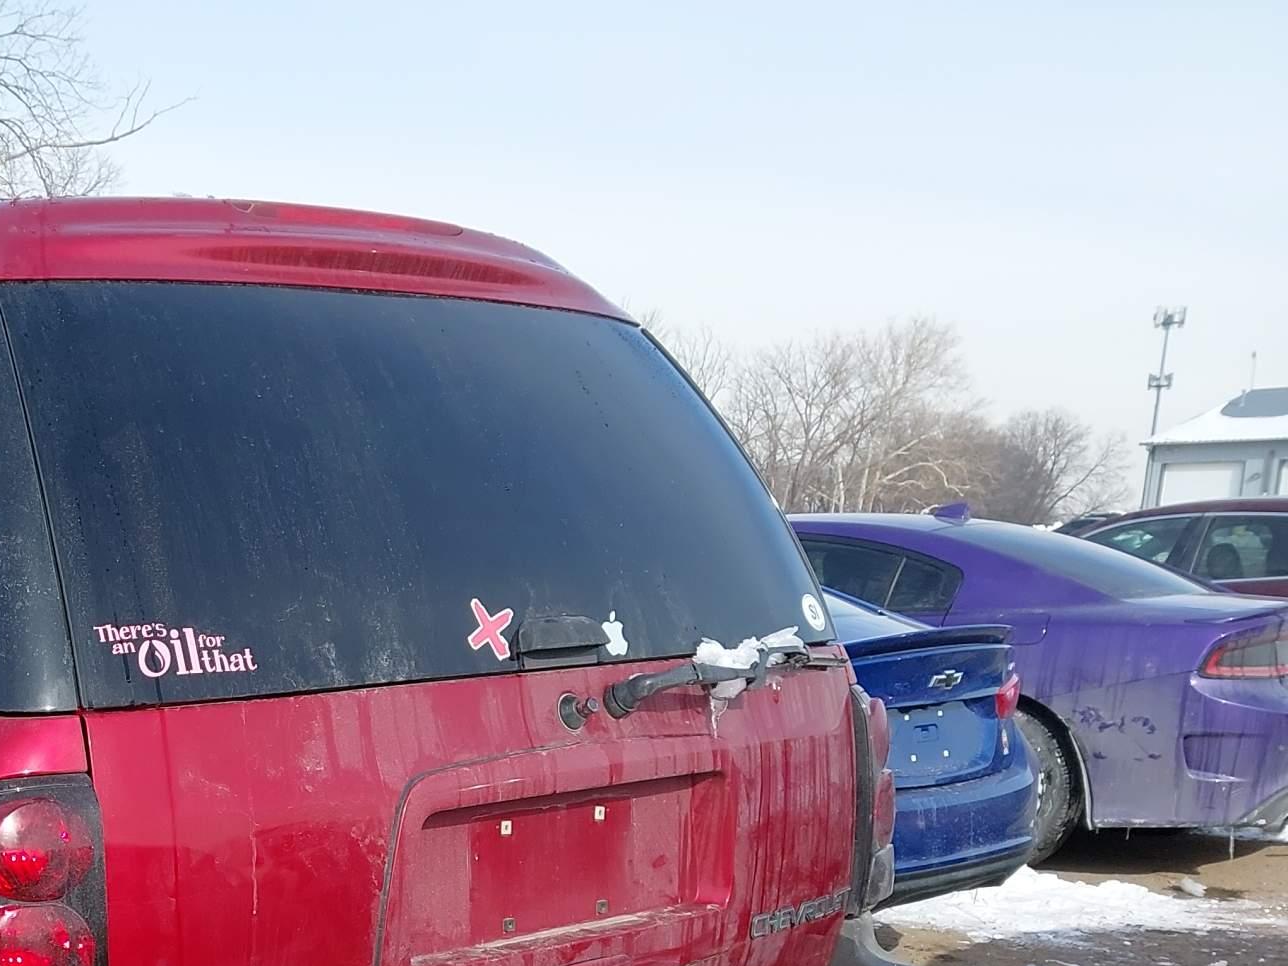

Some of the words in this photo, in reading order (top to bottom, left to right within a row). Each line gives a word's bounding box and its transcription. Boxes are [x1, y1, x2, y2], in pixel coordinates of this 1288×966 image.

[93, 622, 168, 643] There's
[112, 642, 136, 655] an
[198, 634, 225, 648] for
[201, 648, 258, 673] that
[750, 887, 852, 939] CHEVROLET
